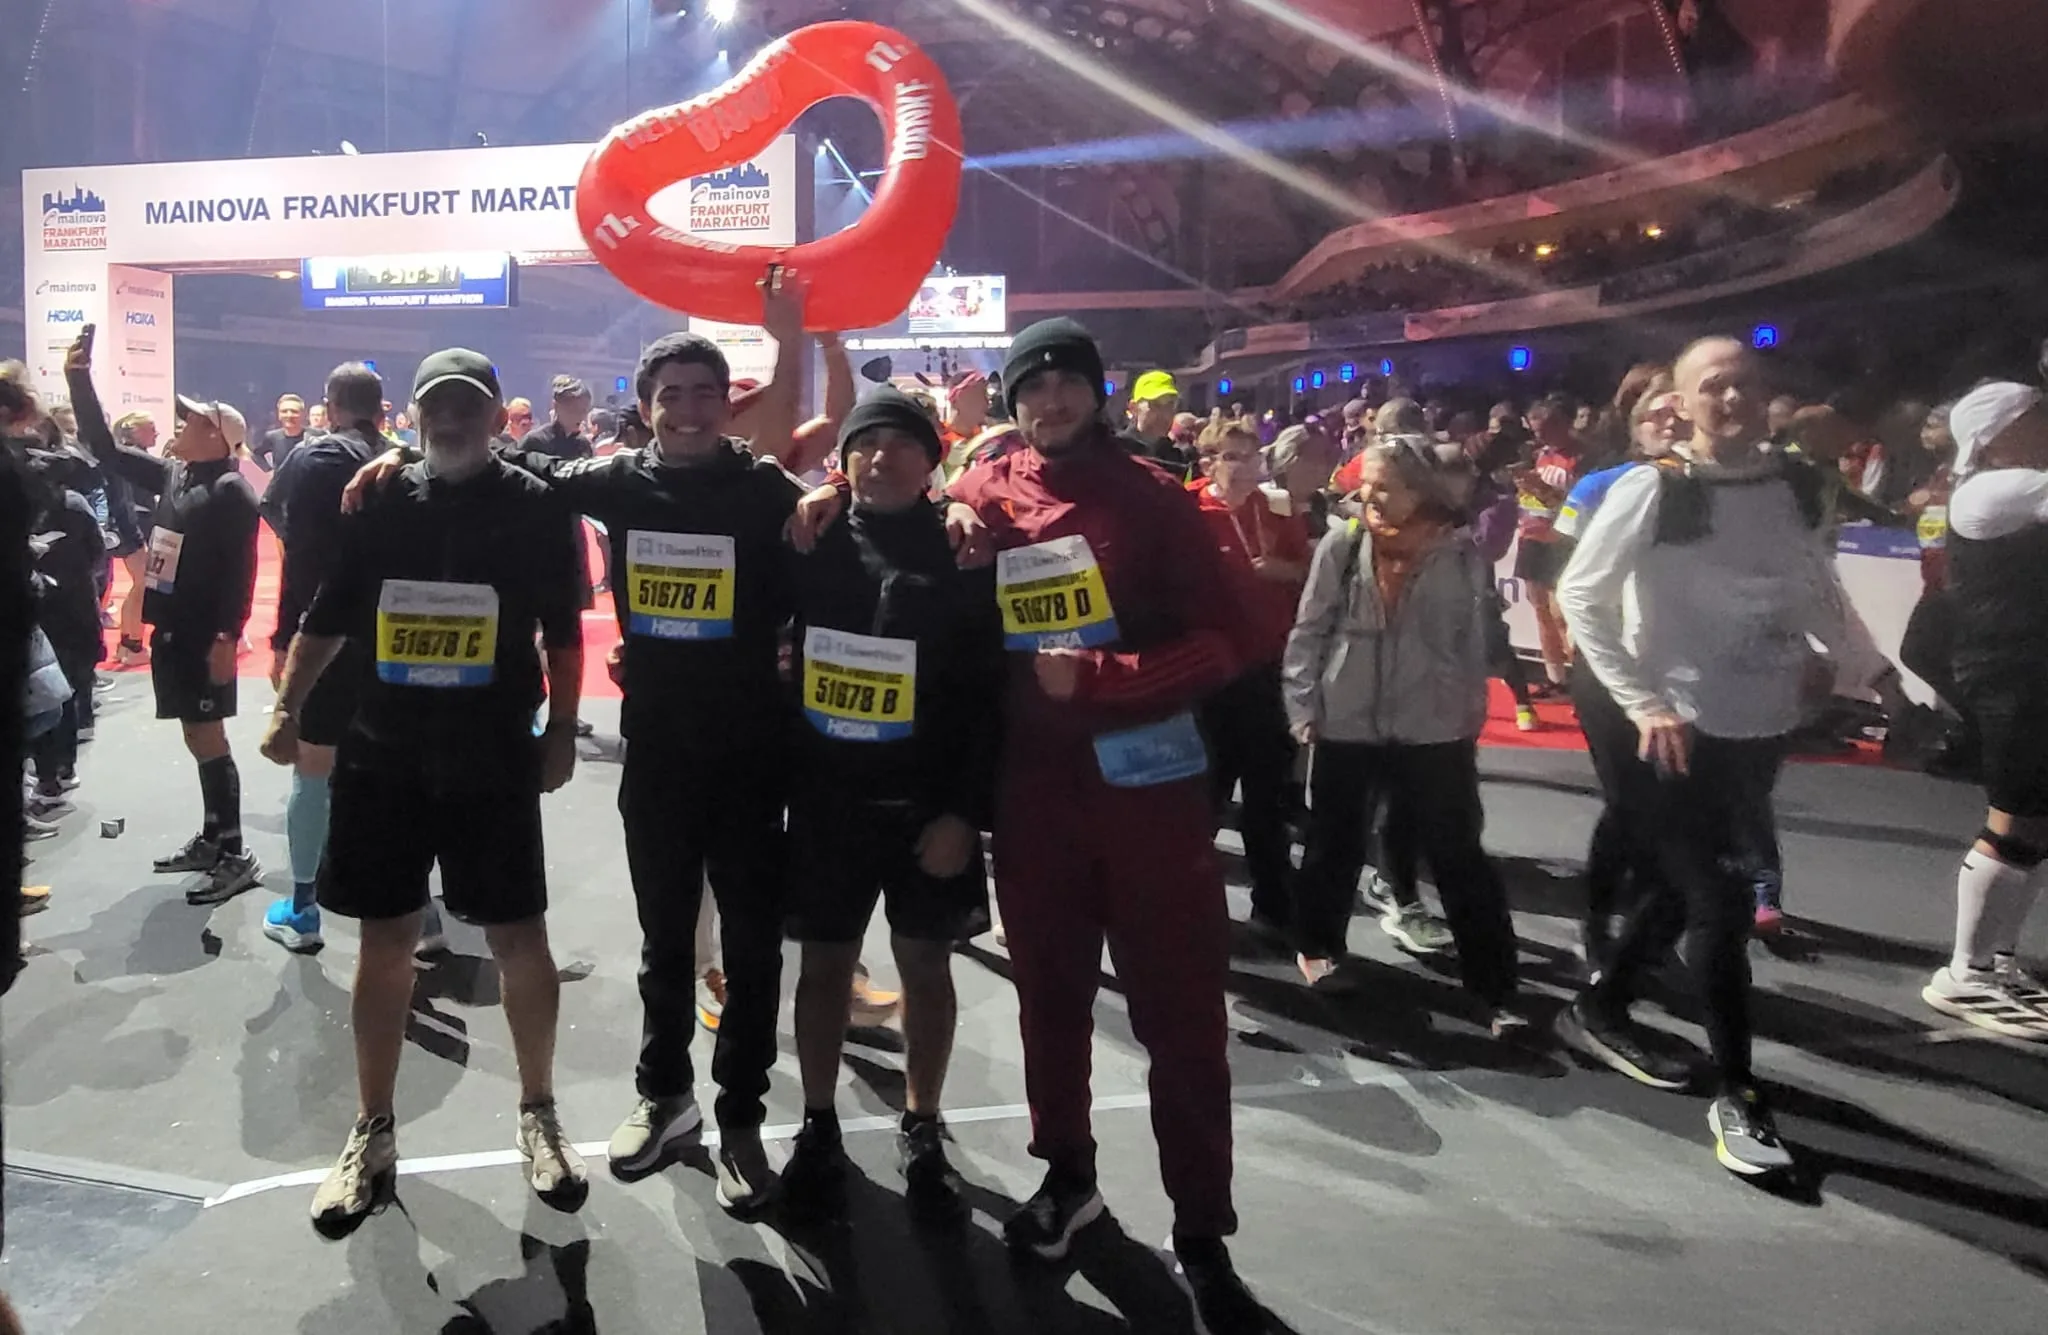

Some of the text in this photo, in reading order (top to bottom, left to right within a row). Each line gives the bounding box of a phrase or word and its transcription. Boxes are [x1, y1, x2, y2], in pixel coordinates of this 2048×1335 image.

[708, 188, 770, 201] mainova
[145, 185, 577, 224] MAINOVA FRANKFURT MARAT
[690, 203, 770, 216] FRANKFURT
[57, 212, 106, 224] mainova
[690, 216, 770, 229] MARATHON
[43, 226, 107, 238] FRANKFURT
[43, 237, 107, 248] MARATHON
[49, 281, 97, 293] mainova
[47, 309, 84, 323] HOKA
[126, 311, 156, 326] HOKA
[638, 578, 717, 611] 51678 A
[1011, 587, 1092, 625] 51678 D
[391, 628, 482, 658] 51678 C
[815, 676, 899, 715] 51678 B
